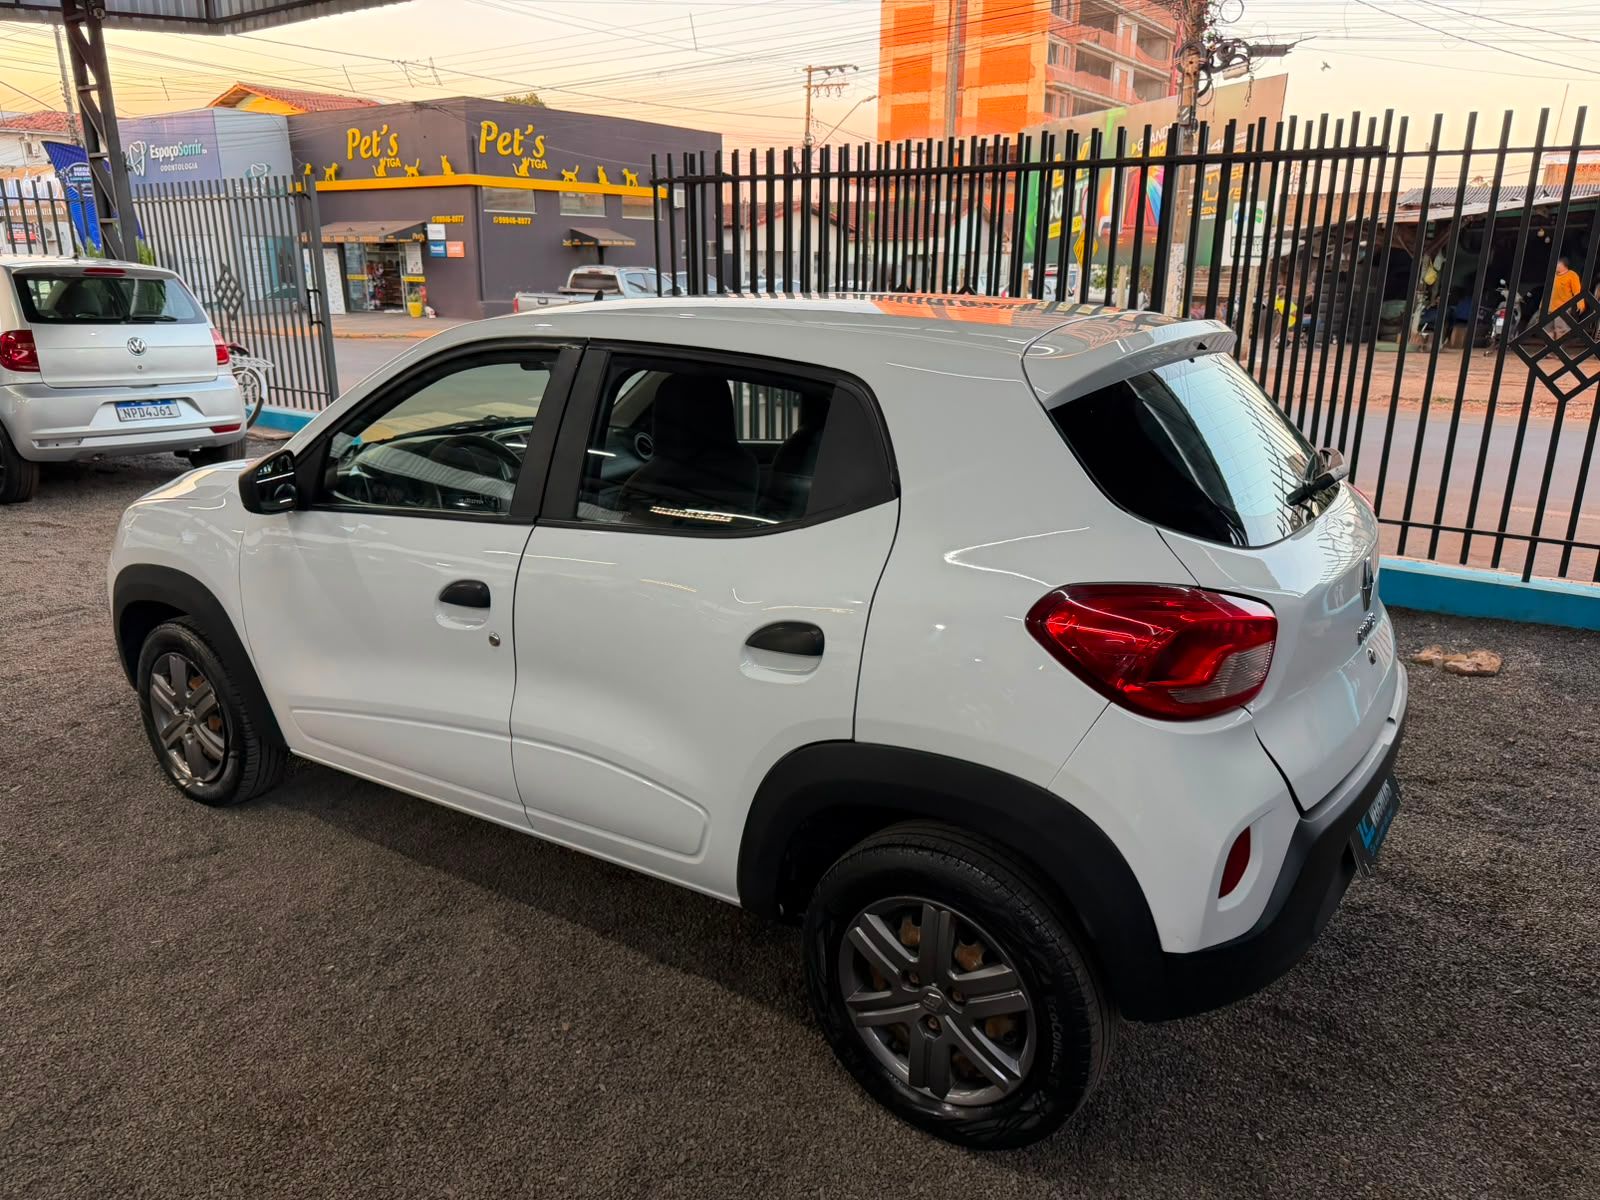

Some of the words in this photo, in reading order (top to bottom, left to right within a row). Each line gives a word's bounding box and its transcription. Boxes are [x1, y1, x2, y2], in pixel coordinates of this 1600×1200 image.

[347, 124, 400, 160] Pet's
[479, 120, 545, 158] Pet's
[160, 162, 198, 172] ODONTOLOGIA
[530, 158, 548, 170] TGA
[122, 405, 174, 419] NPD4J61
